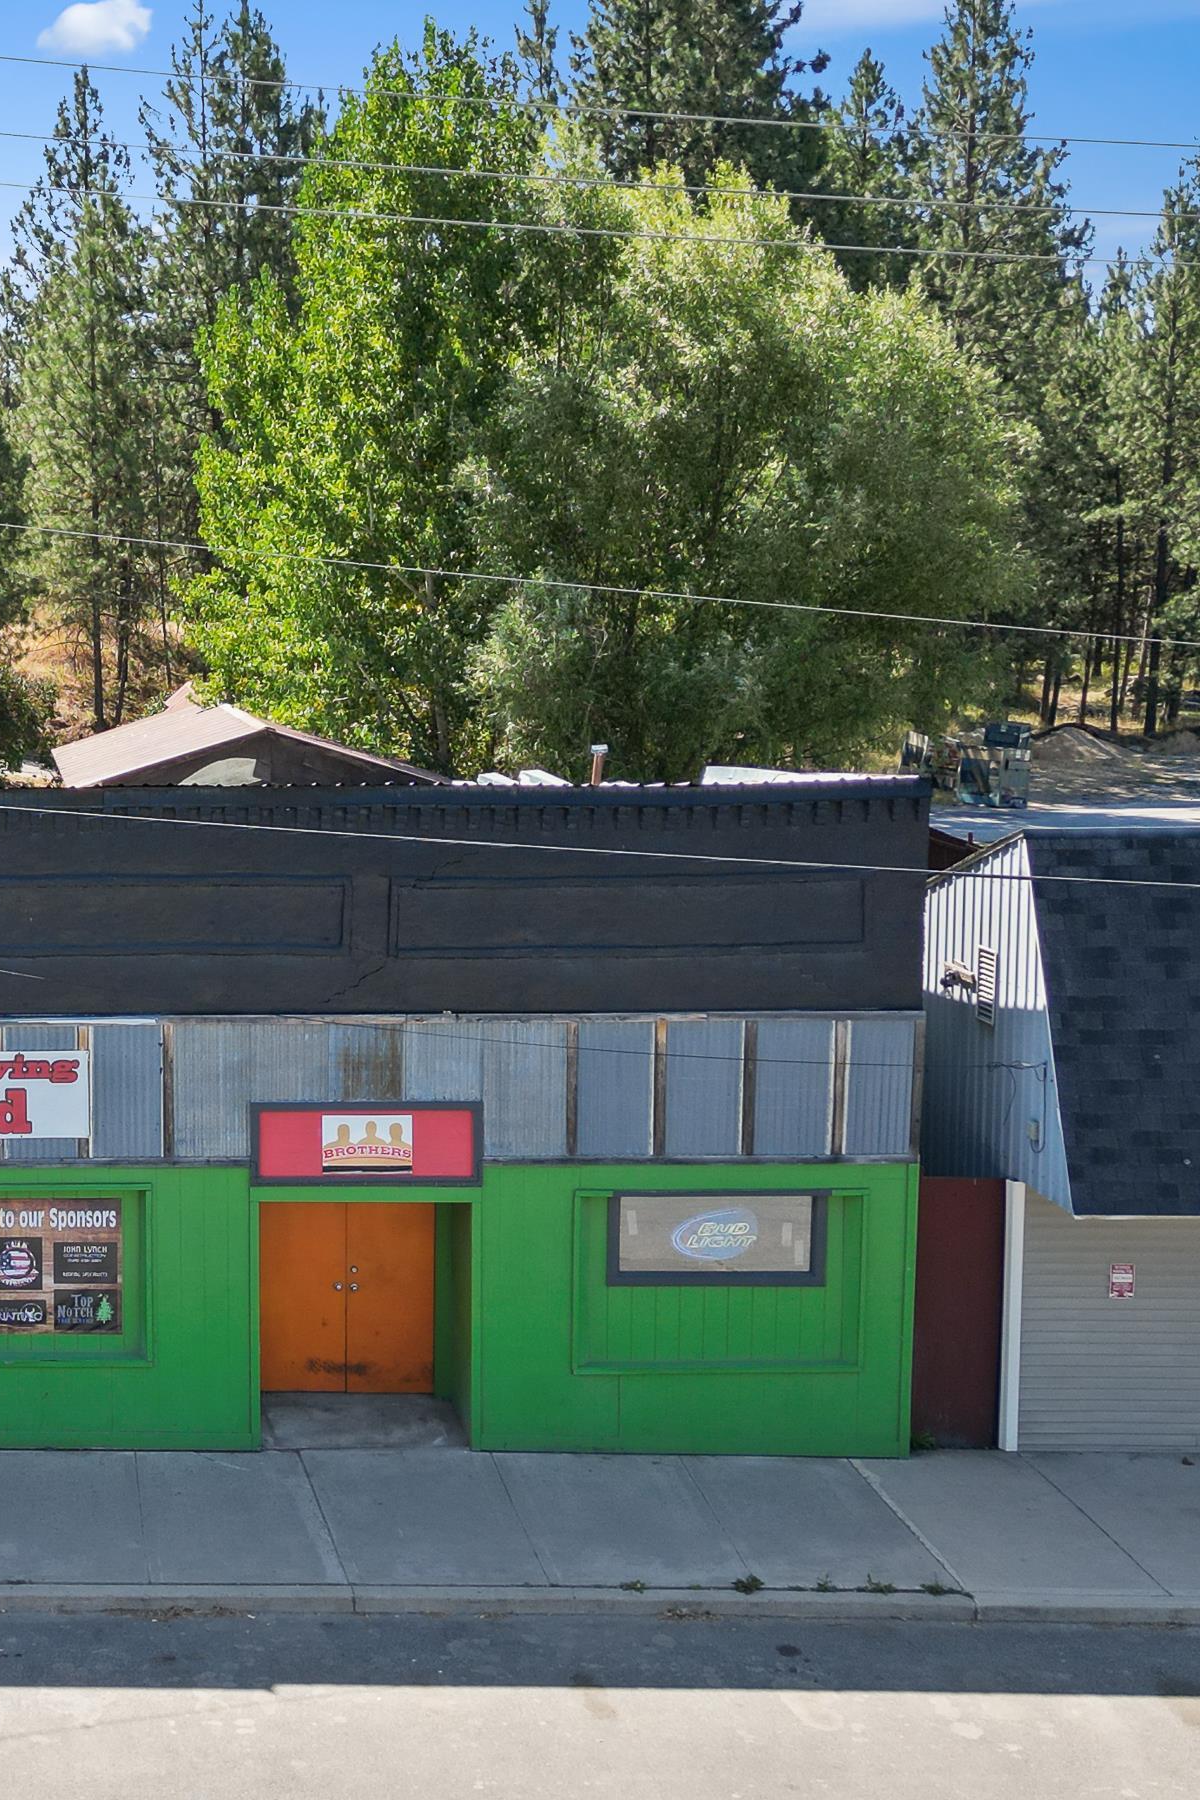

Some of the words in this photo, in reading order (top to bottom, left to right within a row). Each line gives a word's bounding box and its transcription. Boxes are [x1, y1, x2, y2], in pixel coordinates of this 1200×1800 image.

[323, 1145, 412, 1160] BROTHERS
[19, 1210, 44, 1228] our
[49, 1207, 117, 1231] Sponsors
[697, 1222, 750, 1236] BUD
[687, 1235, 758, 1248] LIGHT
